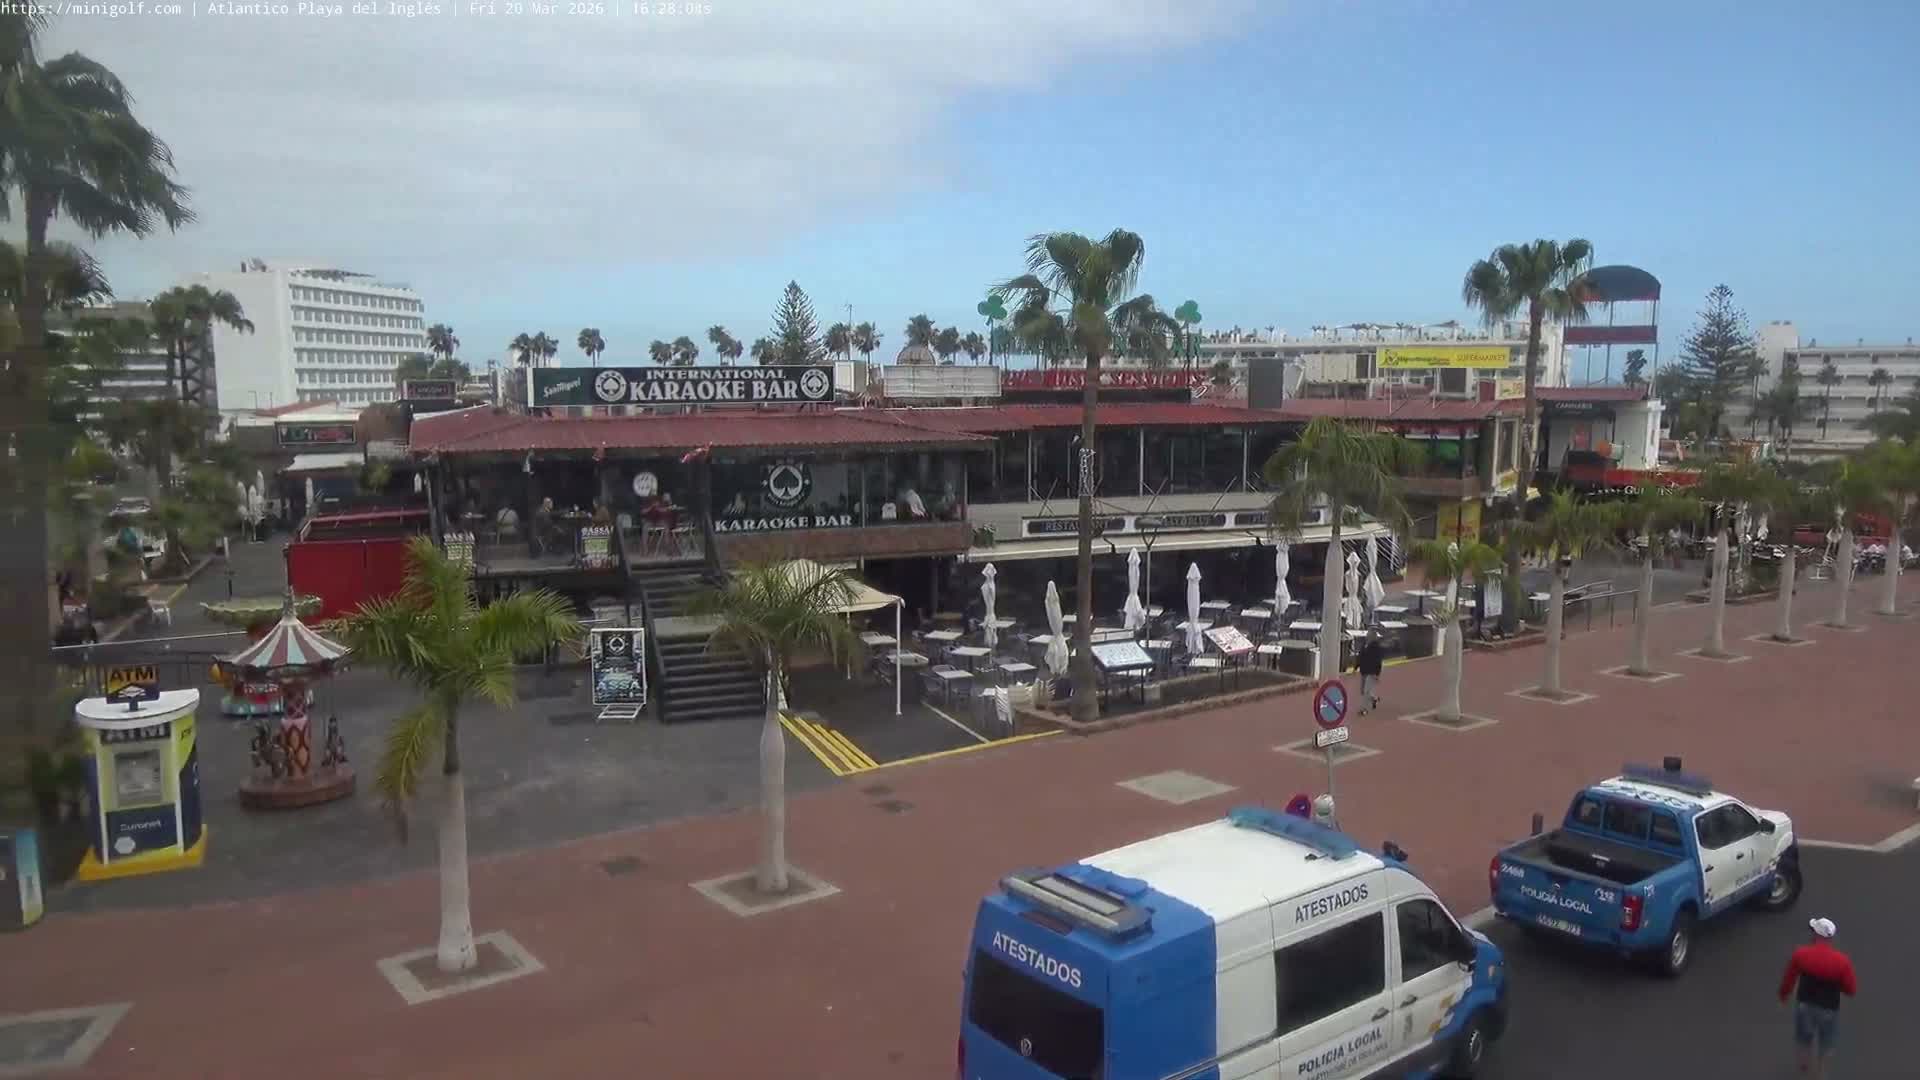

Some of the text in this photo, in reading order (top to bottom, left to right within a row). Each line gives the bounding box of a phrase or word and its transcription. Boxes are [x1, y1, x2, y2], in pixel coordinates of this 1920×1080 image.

[646, 369, 787, 380] INTERNATIONAL
[629, 380, 745, 401] KARAOKE
[751, 380, 798, 400] BAR
[714, 515, 853, 532] KARAOKE BAR
[109, 666, 154, 683] ATM
[105, 724, 166, 743] ATM
[1294, 882, 1369, 925] ATESTADOS
[1559, 897, 1593, 914] LOCAL
[992, 930, 1083, 989] ATESTADOS
[1297, 1045, 1345, 1075] POLICIA
[1348, 1026, 1384, 1055] LOCAL
